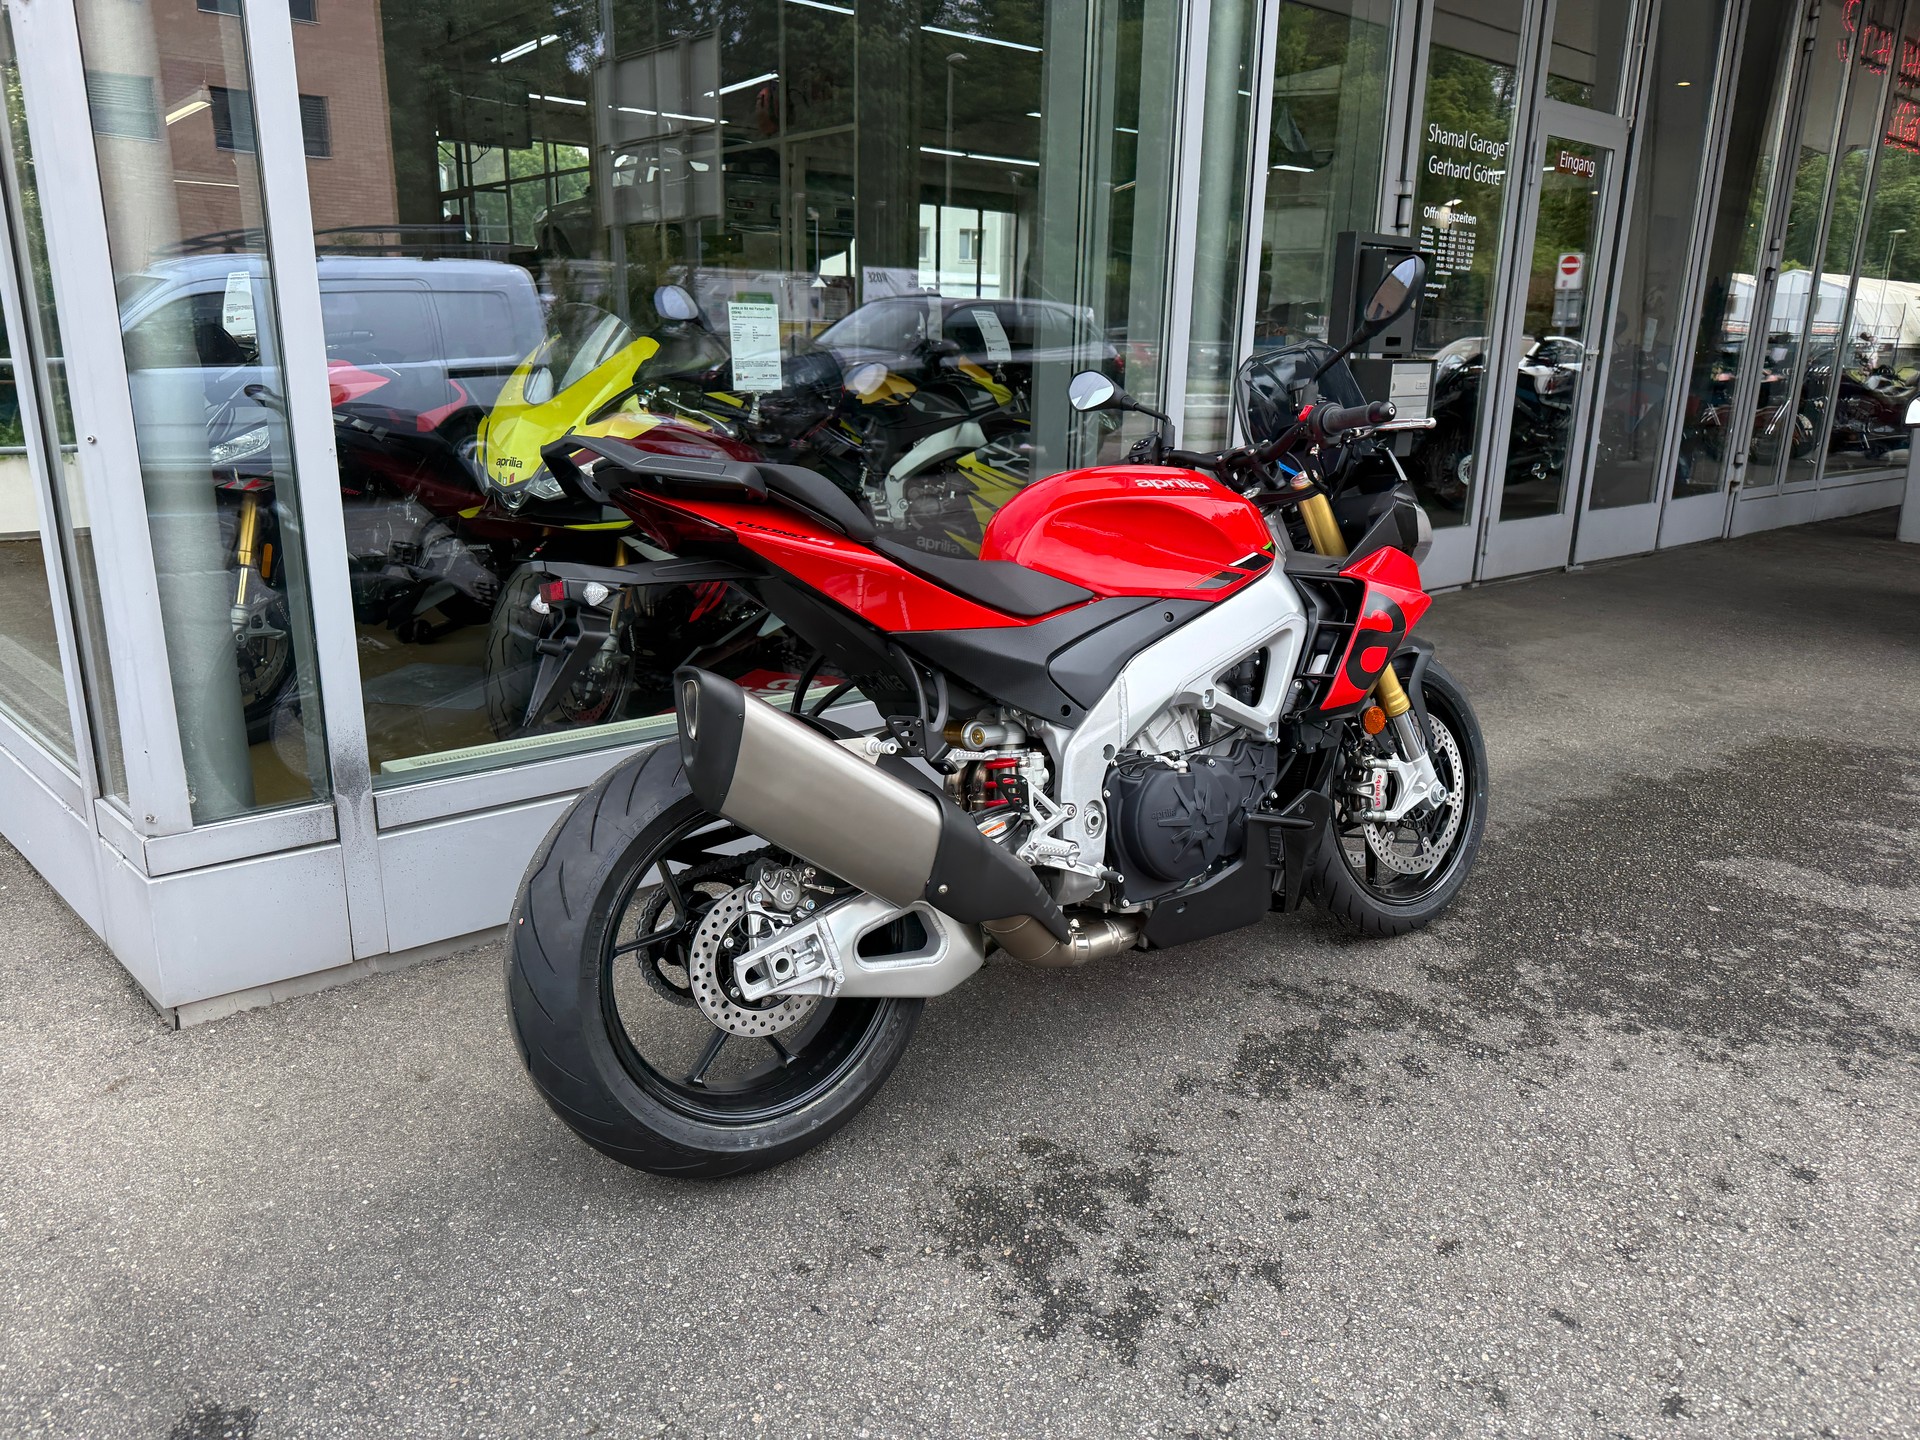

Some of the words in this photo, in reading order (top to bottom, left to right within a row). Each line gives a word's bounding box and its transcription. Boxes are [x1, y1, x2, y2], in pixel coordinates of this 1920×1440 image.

[1428, 123, 1468, 149] Shamal
[1469, 132, 1505, 160] Garage
[1428, 155, 1472, 180] Gerhard
[1473, 163, 1501, 185] Götte
[1559, 150, 1596, 178] Eingang
[496, 457, 523, 468] aprilia
[1134, 478, 1211, 491] aprilia
[916, 536, 961, 555] aprilia
[1374, 774, 1382, 807] brembo
